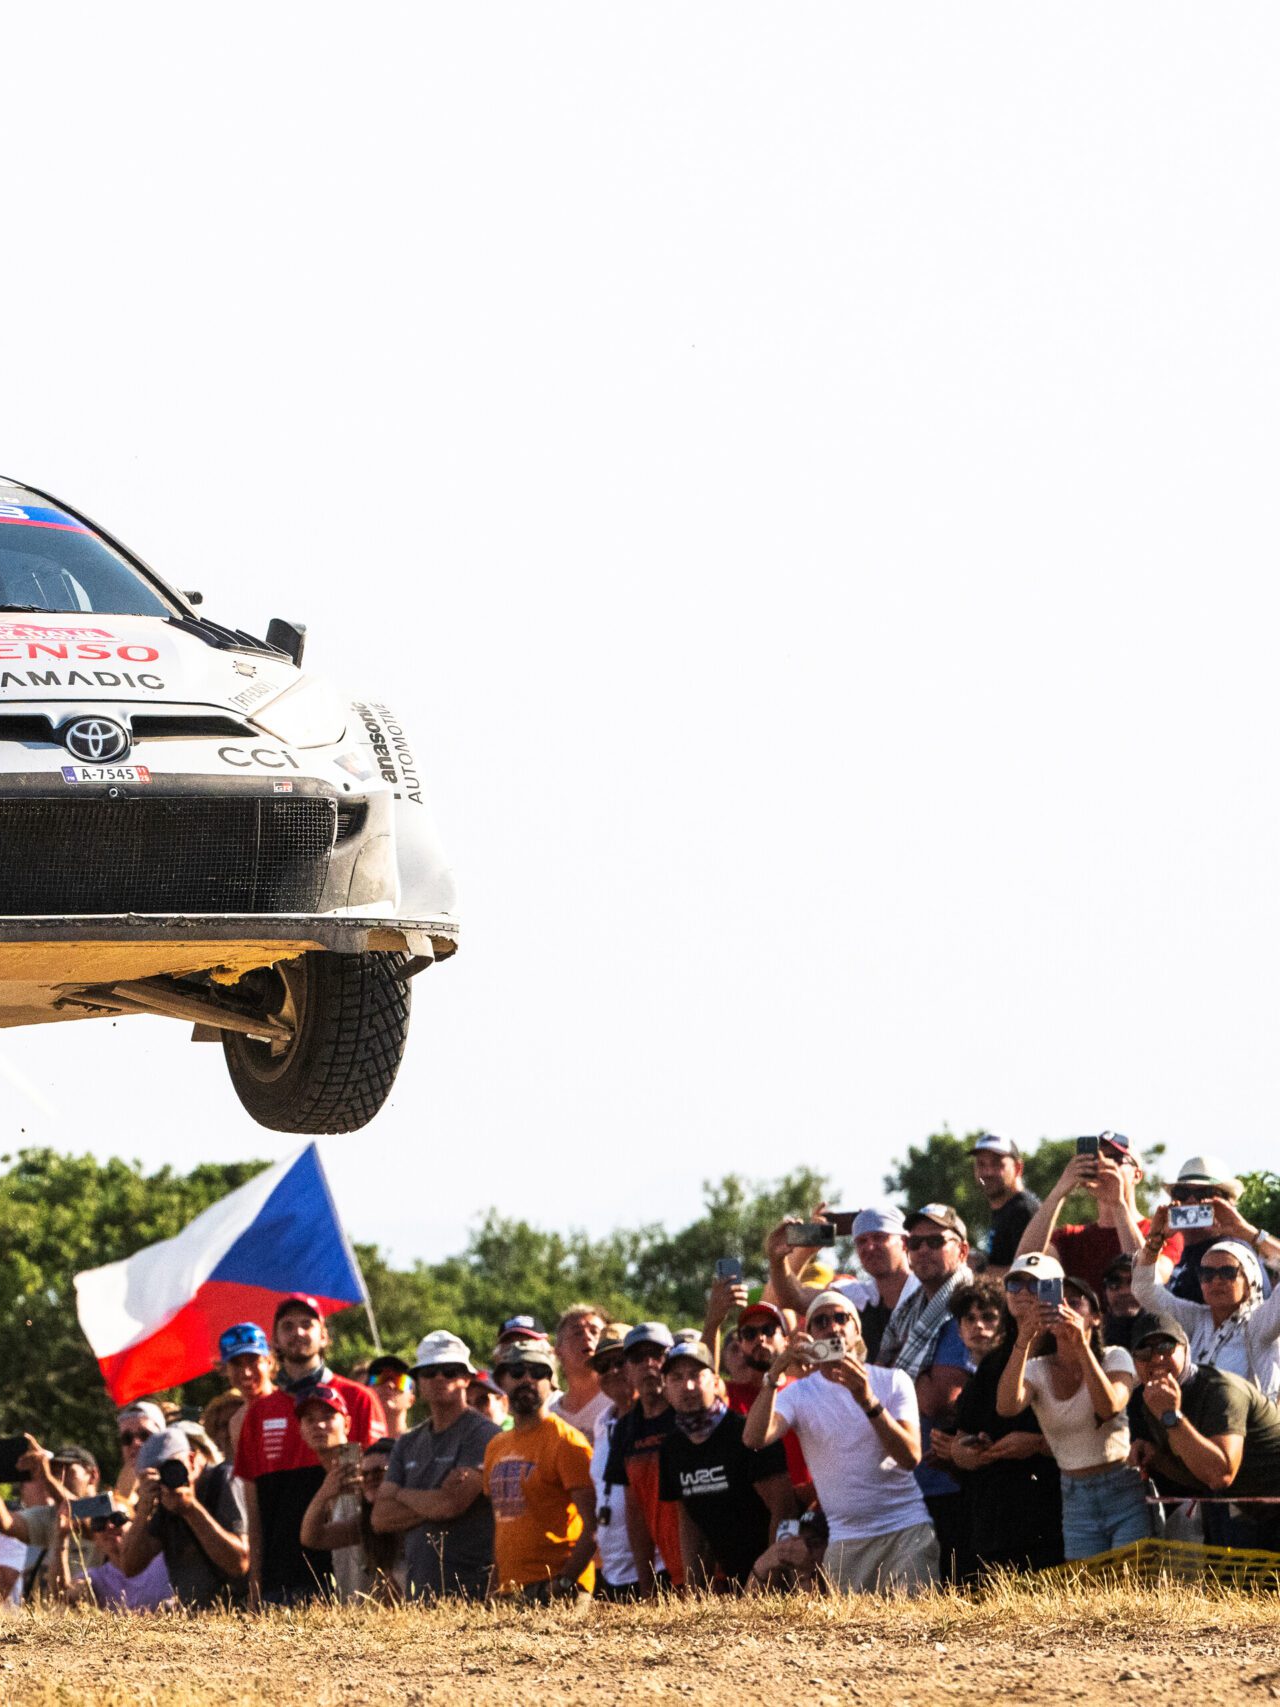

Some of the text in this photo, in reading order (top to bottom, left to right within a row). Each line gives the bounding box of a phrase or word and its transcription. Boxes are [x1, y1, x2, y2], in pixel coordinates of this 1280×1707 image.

[81, 768, 134, 780] A-7545
[351, 701, 402, 800] anasonic
[369, 702, 423, 805] AUTOMOTIVE
[679, 1465, 726, 1487] WRC
